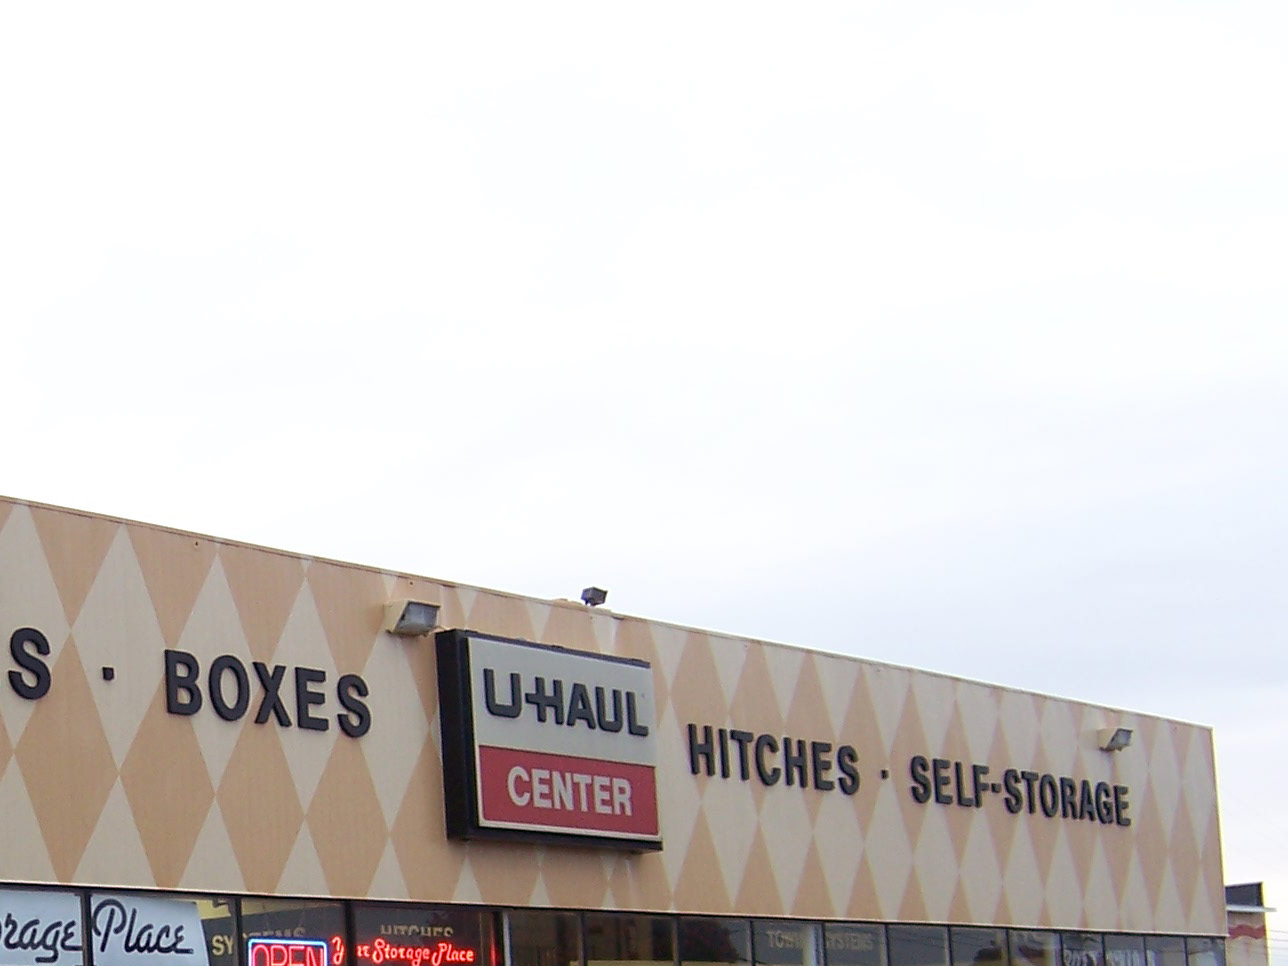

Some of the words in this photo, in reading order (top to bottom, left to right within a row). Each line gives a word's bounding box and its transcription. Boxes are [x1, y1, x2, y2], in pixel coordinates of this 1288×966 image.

[164, 649, 372, 738] BOXES
[483, 668, 650, 737] U-HAUL
[506, 766, 634, 817] CENTER
[687, 723, 860, 795] HITCHES
[910, 755, 1132, 828] SELF-STORAGE
[91, 898, 194, 955] Place
[431, 941, 476, 966] Place
